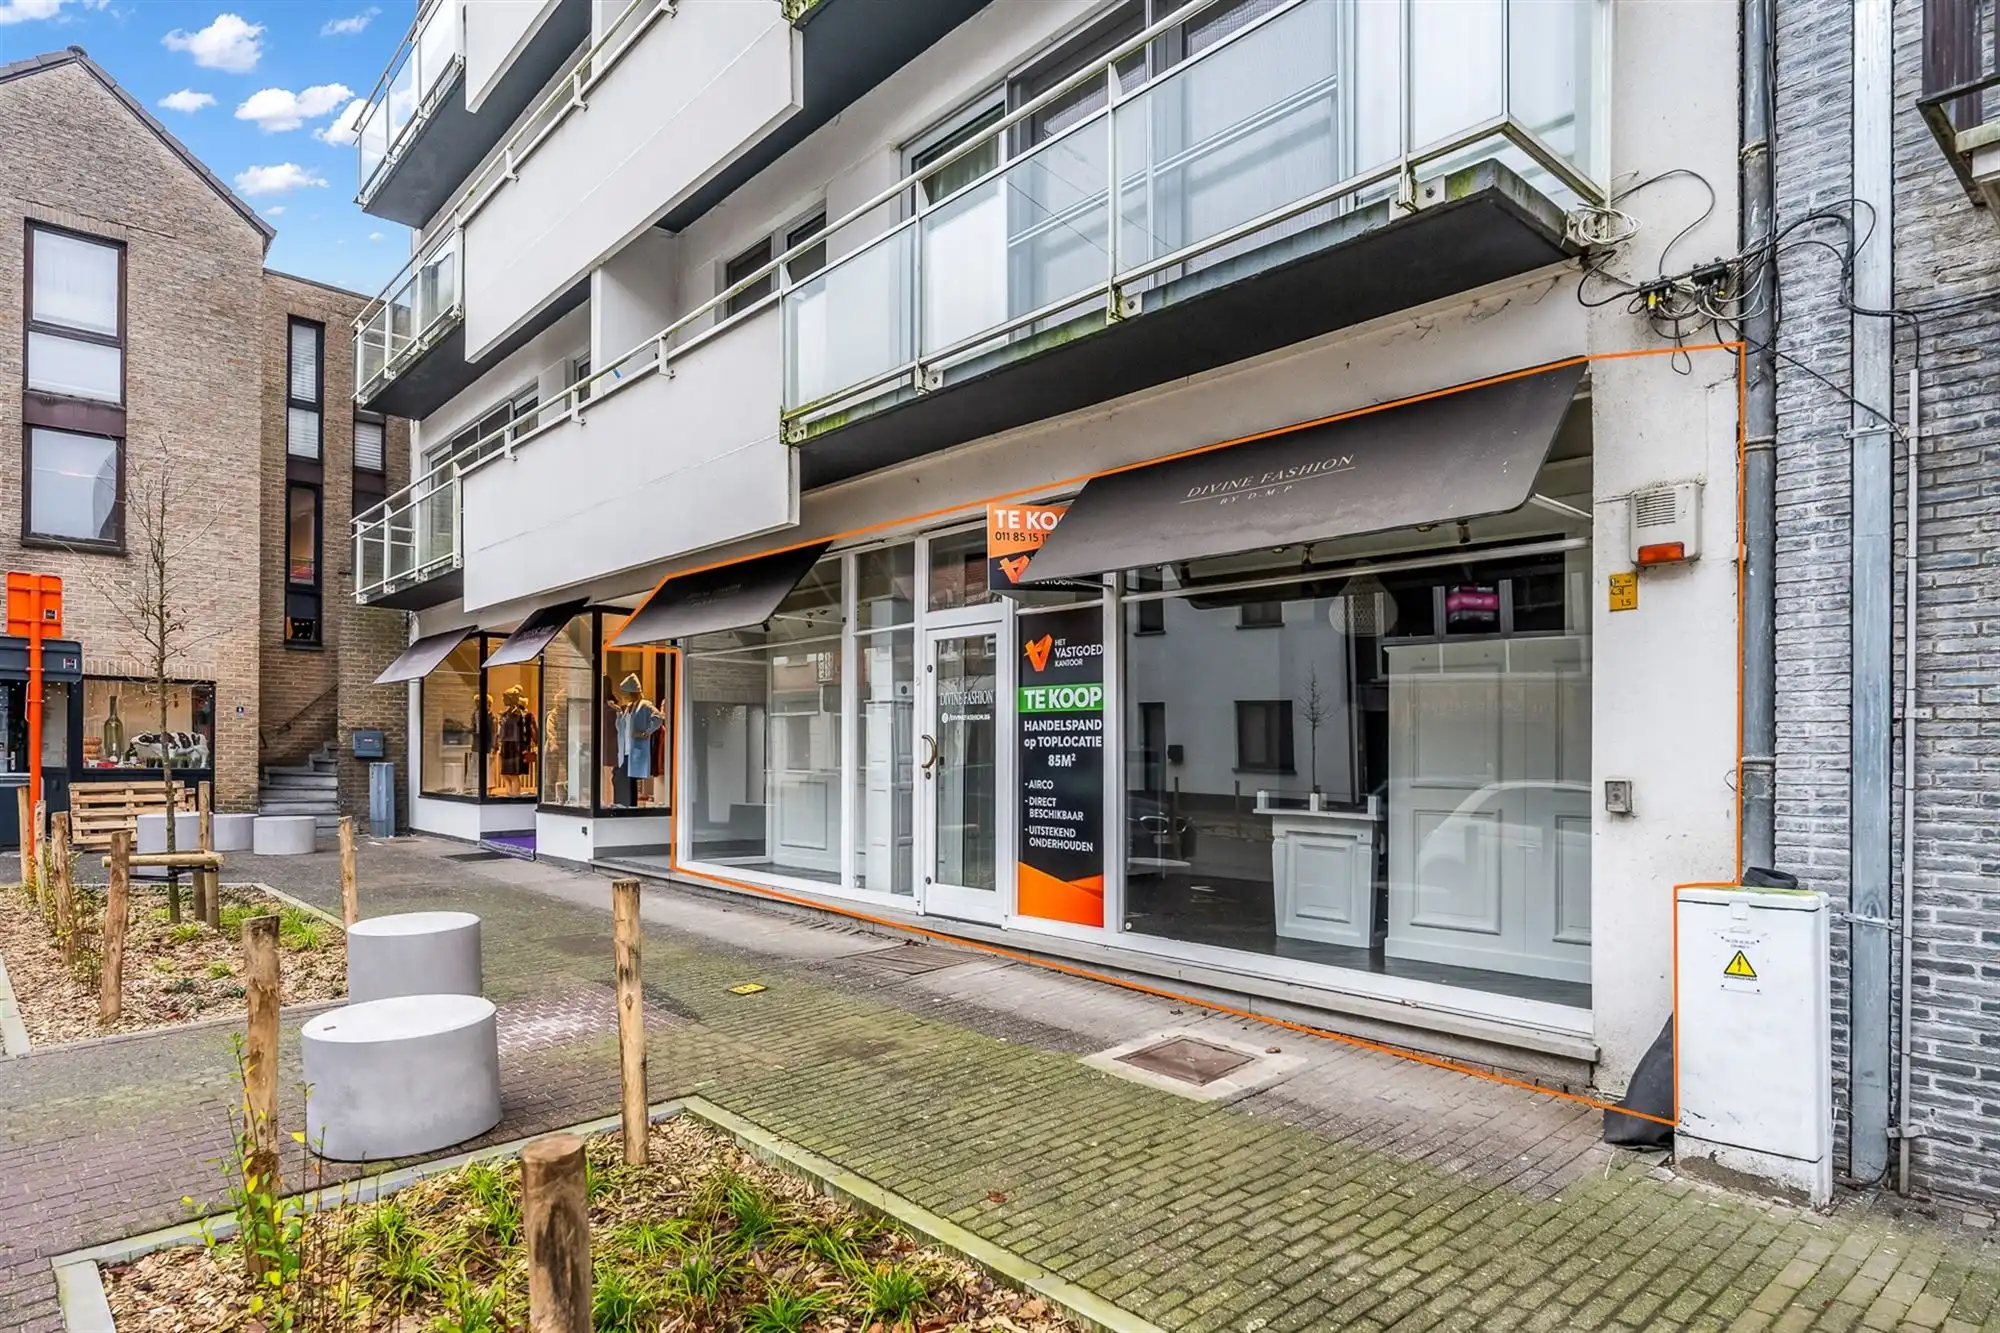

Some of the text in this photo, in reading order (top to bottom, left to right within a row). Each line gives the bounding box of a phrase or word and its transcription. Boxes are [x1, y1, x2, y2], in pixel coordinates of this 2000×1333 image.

[1186, 454, 1354, 498] DIVINE FASHION
[1219, 495, 1239, 505] BY
[994, 509, 1020, 529] TE
[995, 531, 1010, 541] 011
[1013, 532, 1026, 542] 85
[1029, 533, 1039, 542] 15
[1054, 638, 1066, 646] HET
[1054, 644, 1103, 658] VASTGOED
[1054, 659, 1084, 667] KANTOOR
[940, 690, 993, 706] DIVINE FASHION
[1024, 686, 1102, 710] TE KOOP
[1024, 719, 1102, 732] HANDELSPAND
[1024, 736, 1102, 750] op TOPLOCATIE
[1029, 808, 1084, 821] BESCHIKBAAR
[1029, 837, 1094, 852] ONDERHOUDEN
